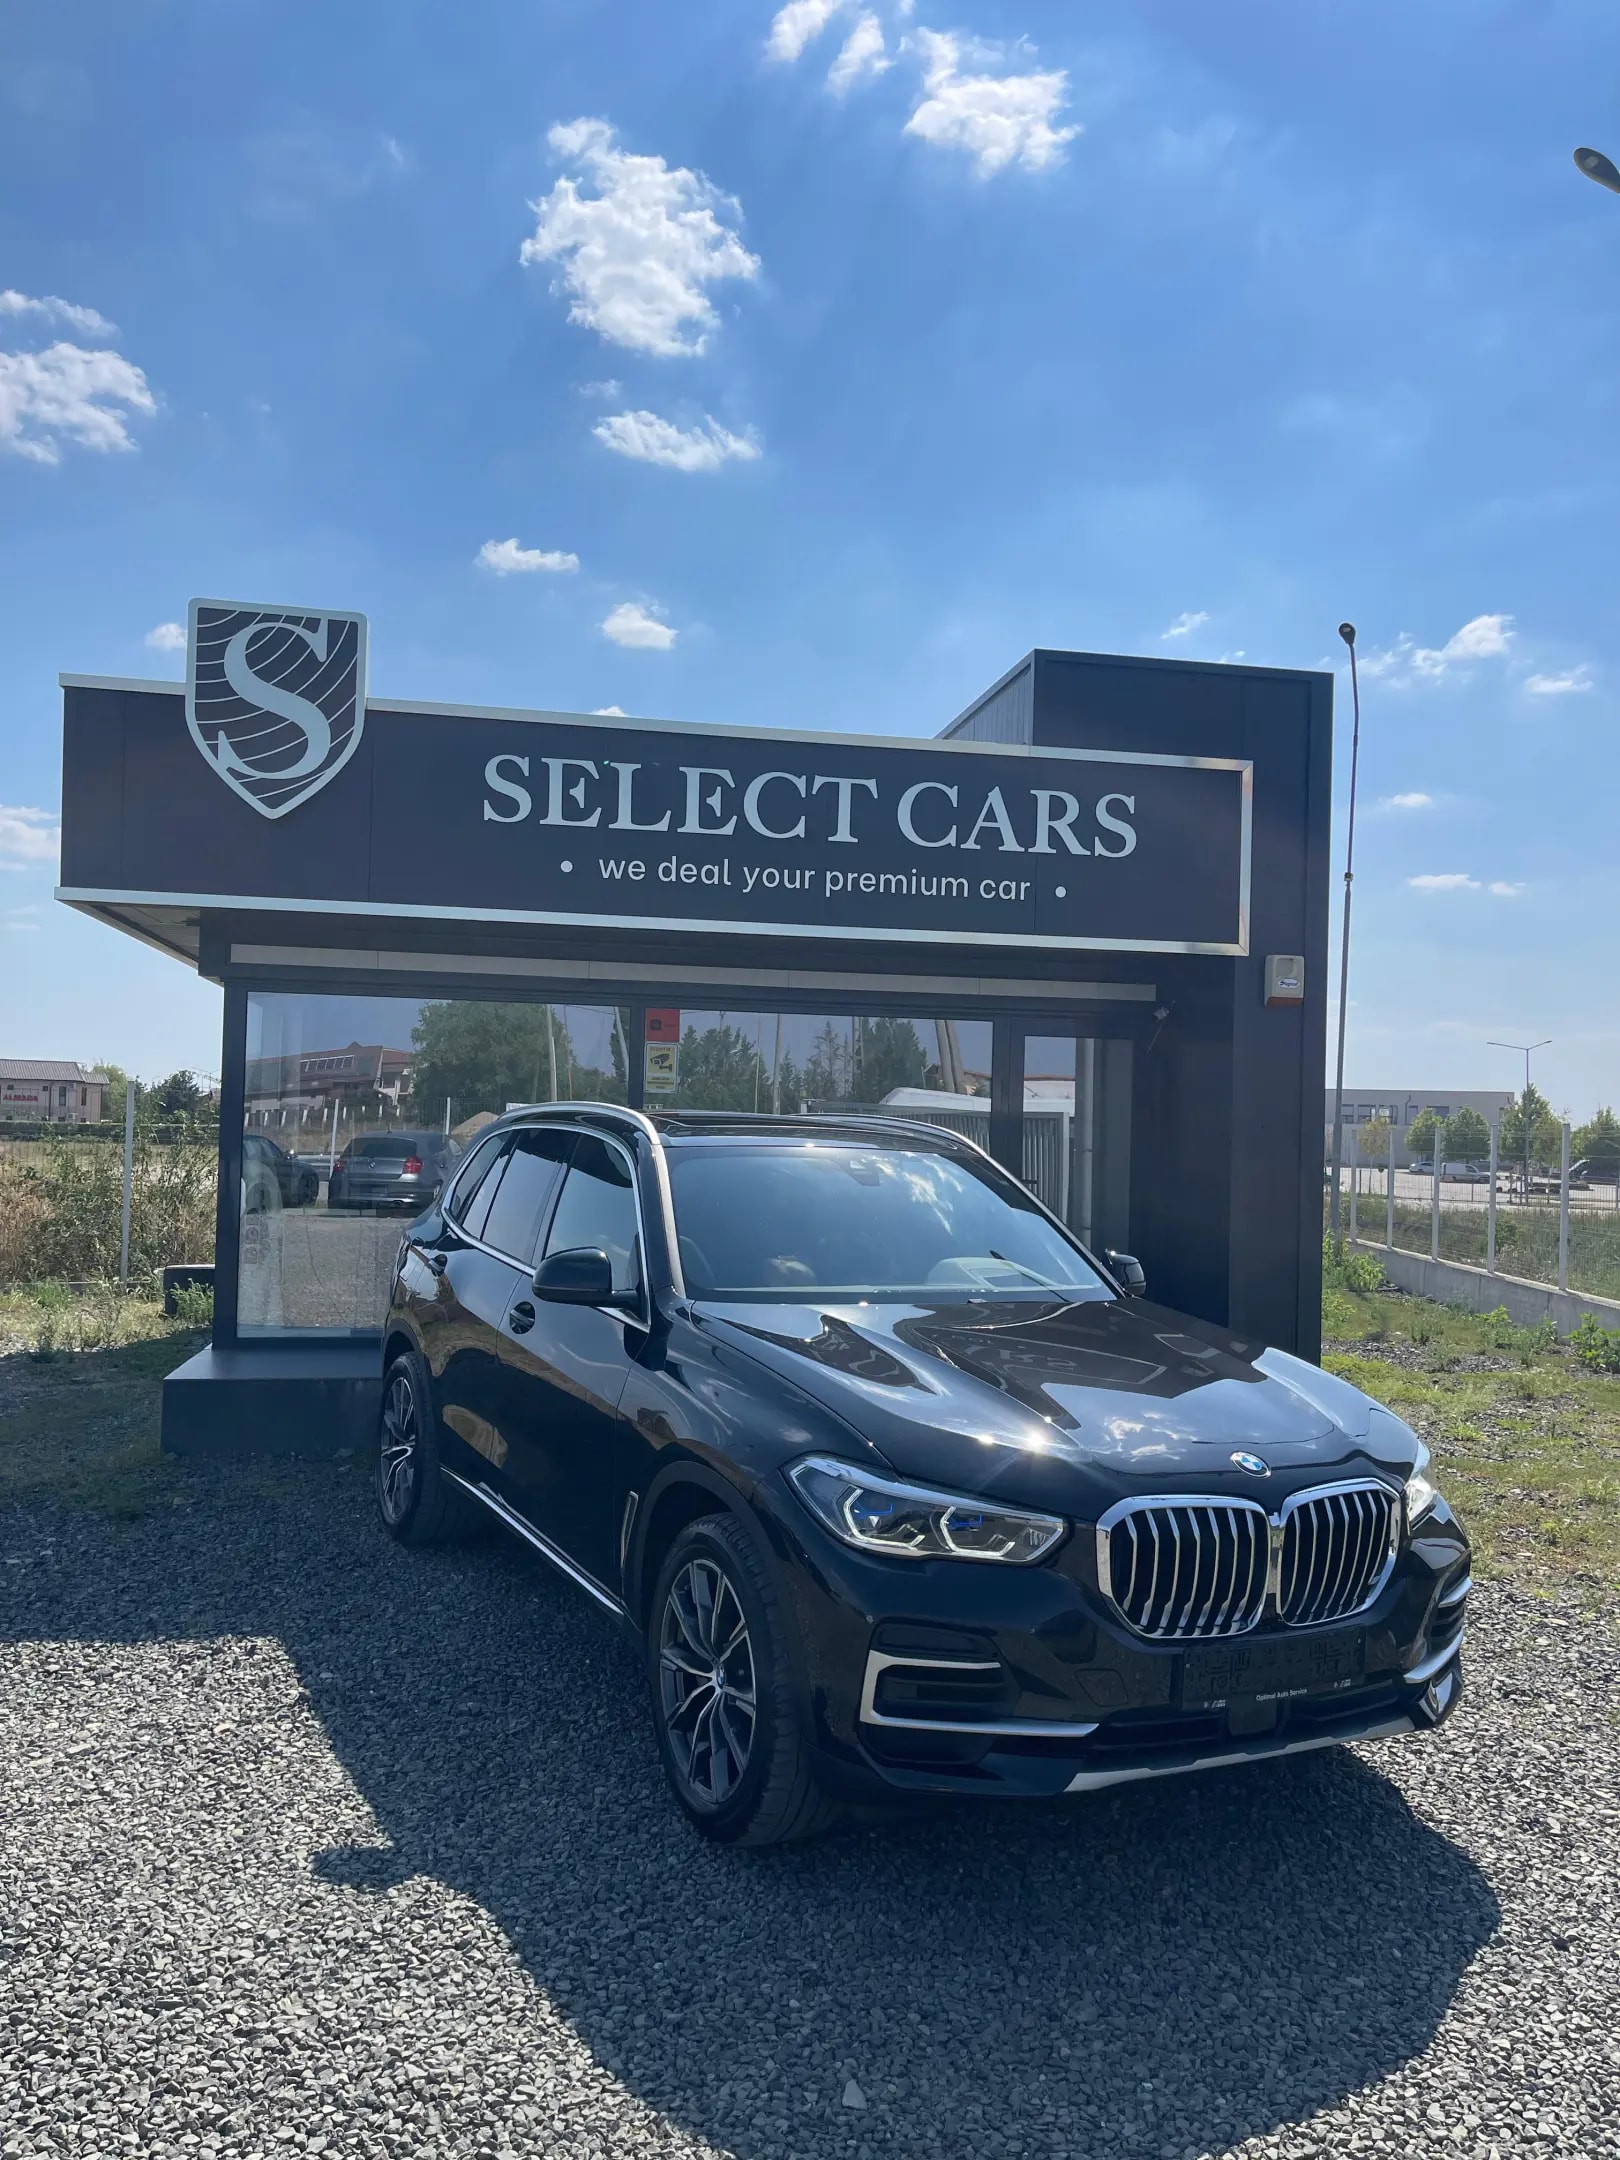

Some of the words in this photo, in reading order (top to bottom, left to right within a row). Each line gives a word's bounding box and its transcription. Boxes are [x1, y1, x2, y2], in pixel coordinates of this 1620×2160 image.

[218, 618, 331, 780] S
[483, 754, 879, 843] SELECT
[897, 781, 1137, 858] CARS
[598, 858, 646, 881] we
[657, 855, 732, 886] deal
[742, 866, 816, 893] your
[825, 870, 969, 898] premium
[979, 879, 1031, 901] car
[1276, 1691, 1289, 1699] Auto
[1289, 1688, 1308, 1697] Service
